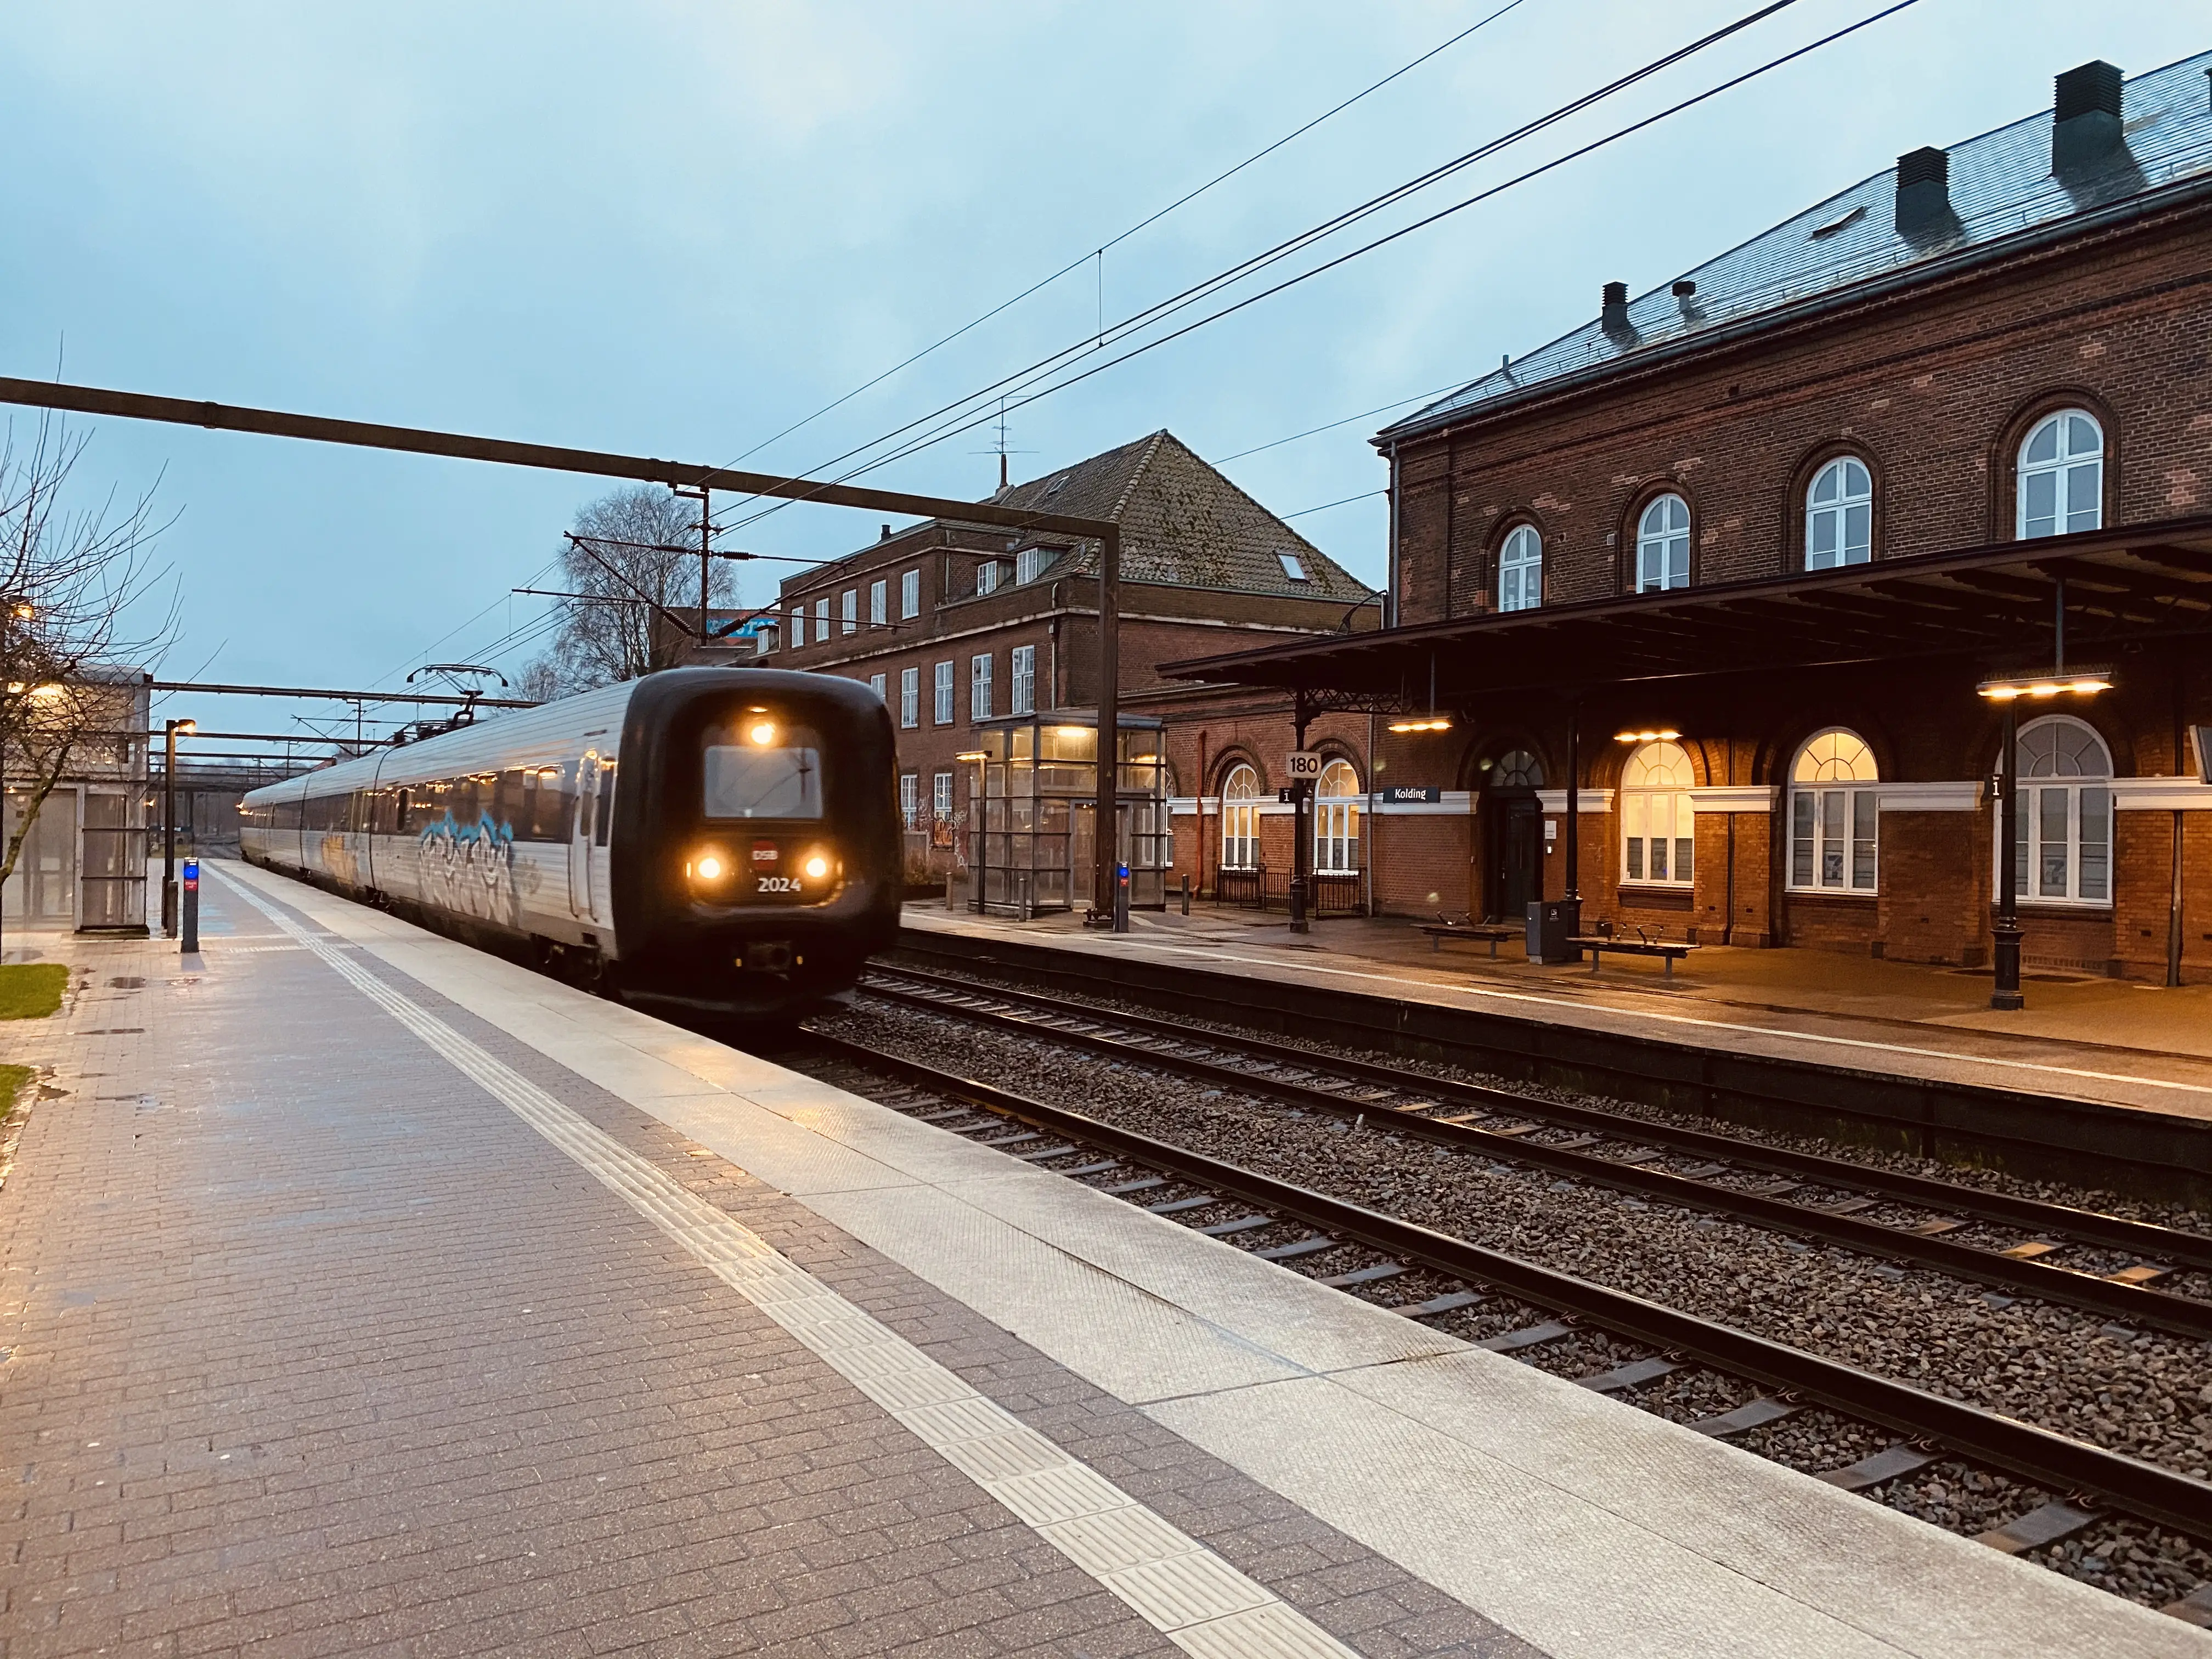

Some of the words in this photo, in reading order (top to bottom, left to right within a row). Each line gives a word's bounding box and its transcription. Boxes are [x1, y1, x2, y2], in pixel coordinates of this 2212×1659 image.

[1290, 757, 1318, 774] 180
[1395, 788, 1426, 800] Kolding
[1993, 781, 2000, 795] 1
[1284, 792, 1289, 802] 1
[758, 877, 801, 892] 2024
